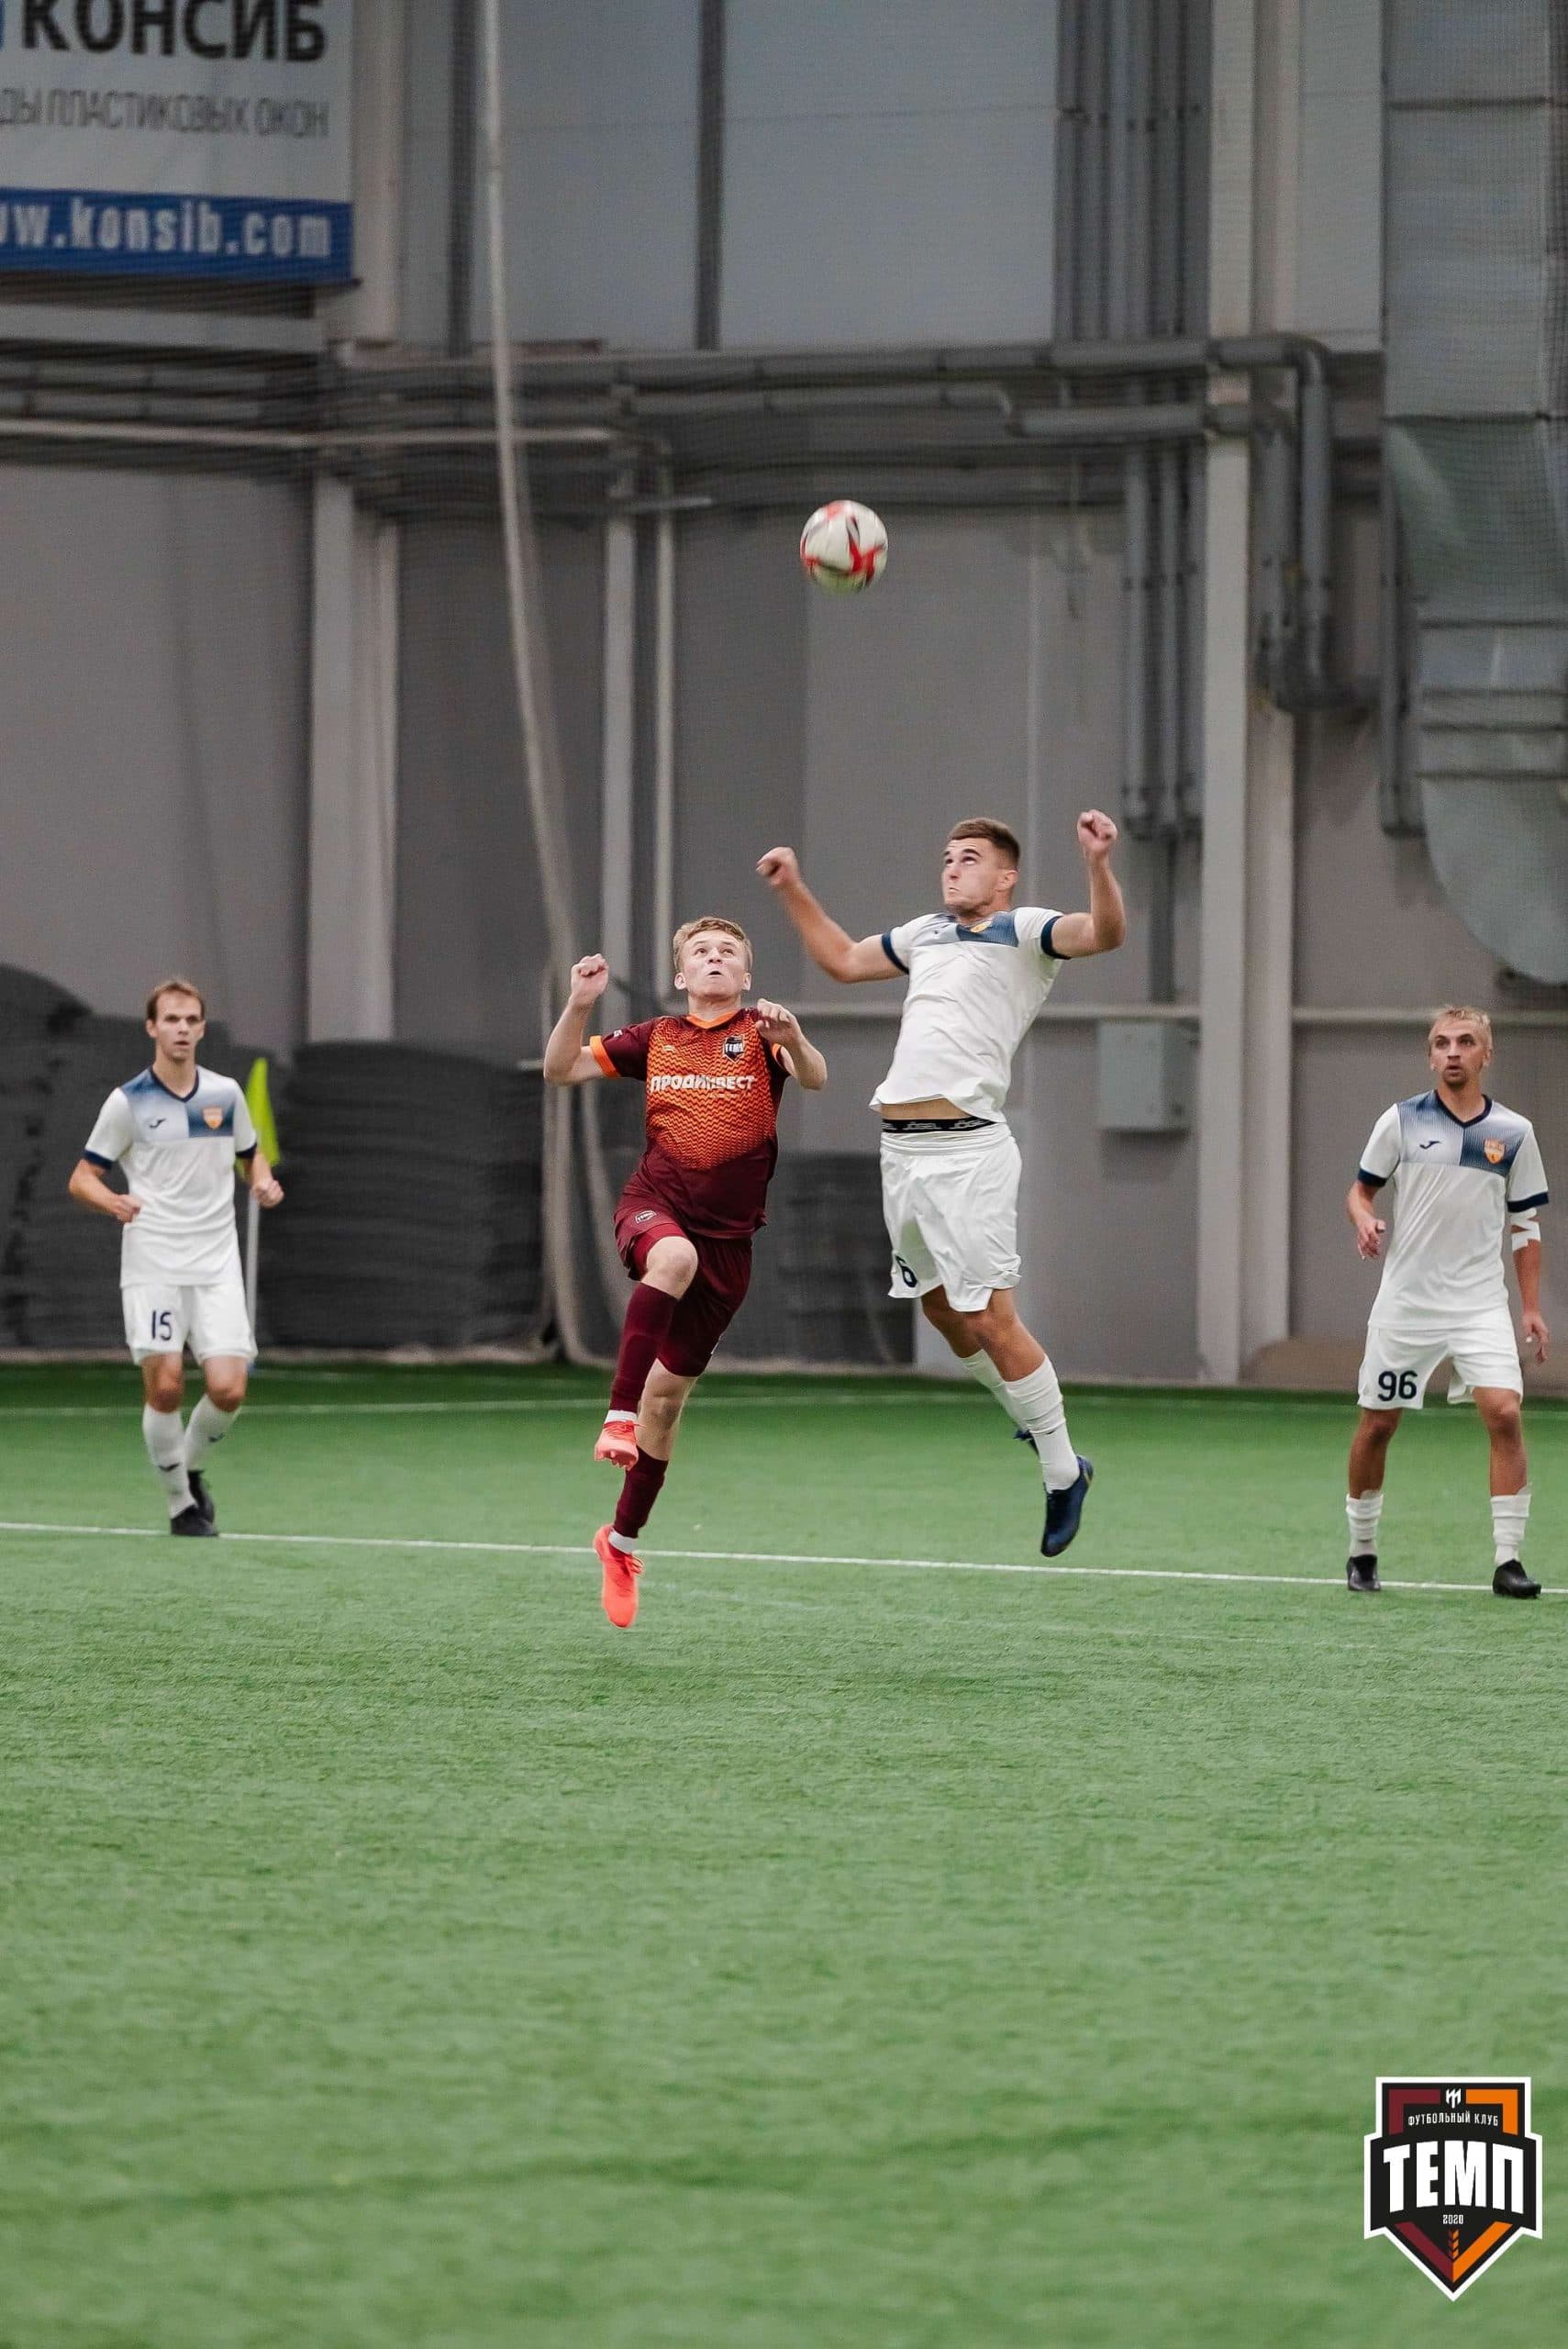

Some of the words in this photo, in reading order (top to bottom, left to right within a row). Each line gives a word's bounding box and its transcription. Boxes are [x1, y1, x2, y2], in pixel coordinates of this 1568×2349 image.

[22, 0, 328, 61] КОНСИБ
[0, 196, 331, 257] w.konsib.com
[151, 1310, 172, 1341] 15
[1377, 1370, 1418, 1402] 96
